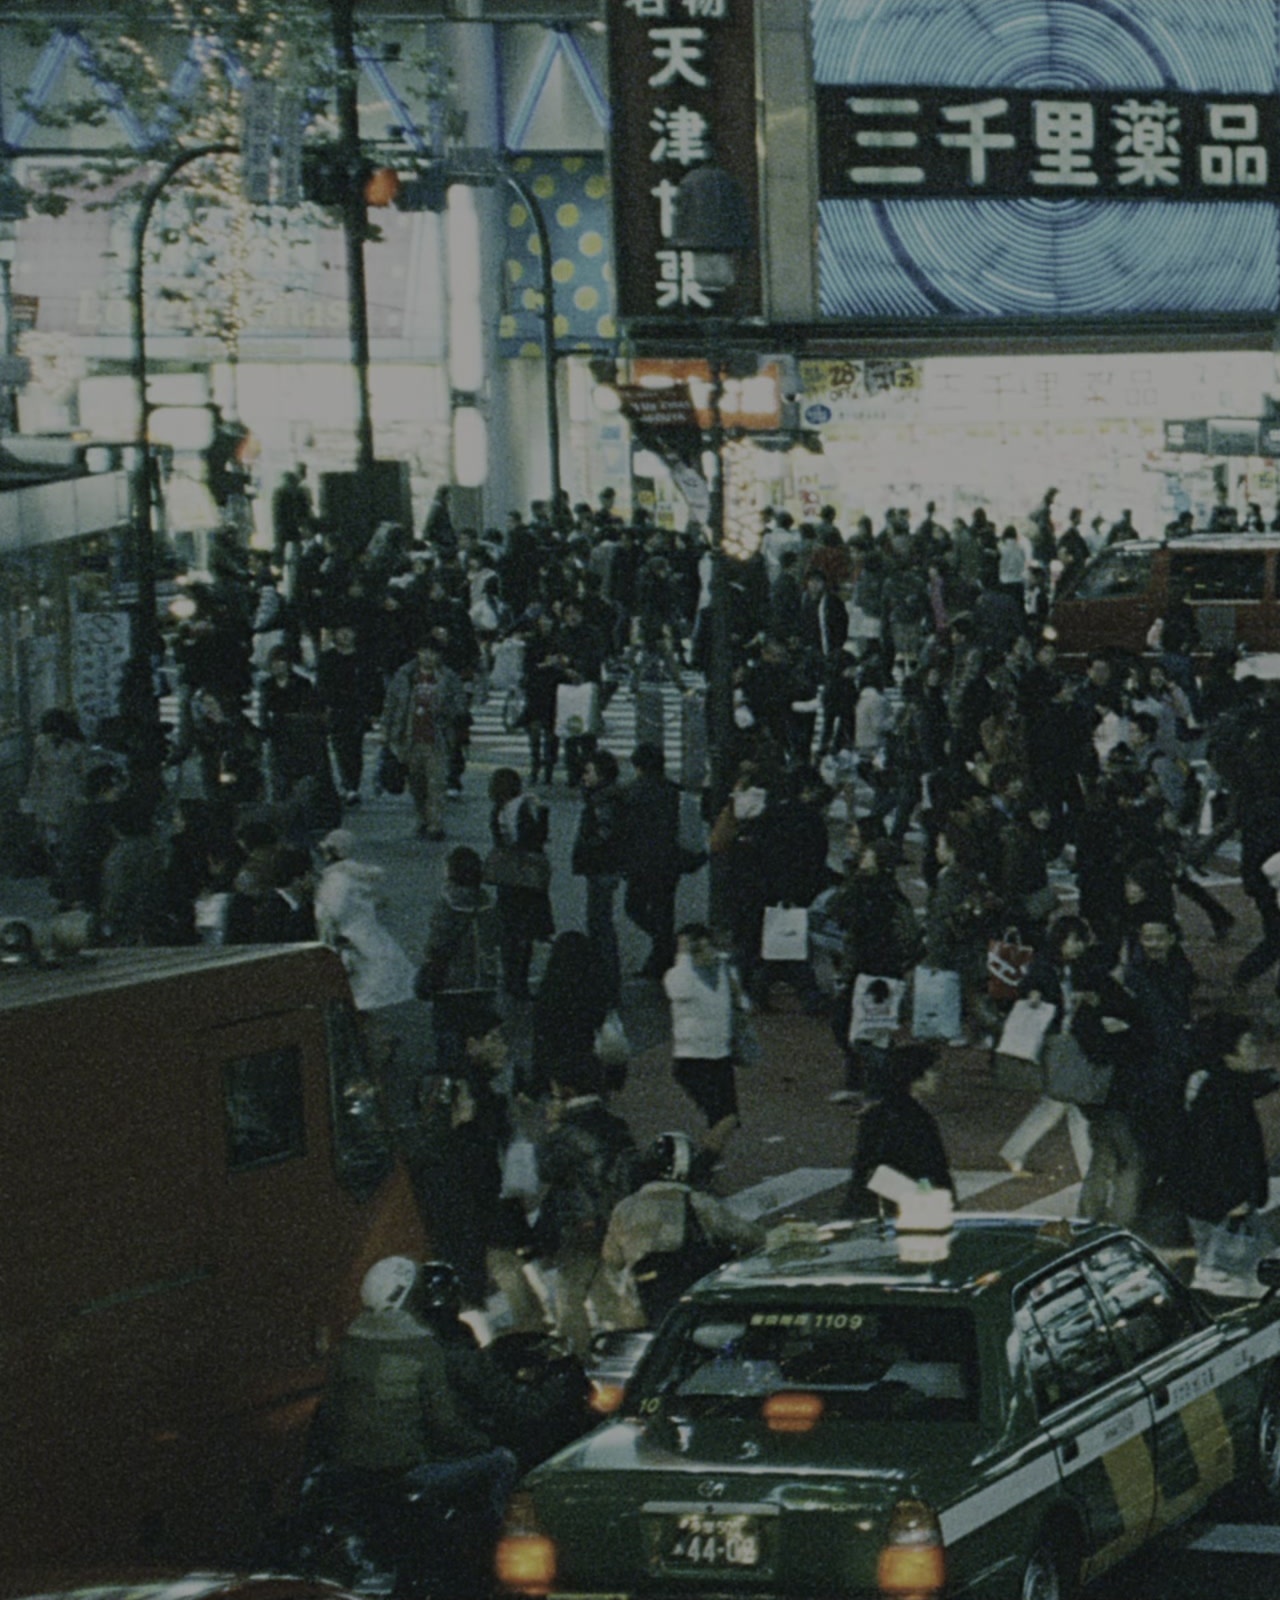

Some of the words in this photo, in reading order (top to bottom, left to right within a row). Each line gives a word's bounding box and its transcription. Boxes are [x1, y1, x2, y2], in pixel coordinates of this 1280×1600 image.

[847, 97, 1268, 185] 三千里薬品
